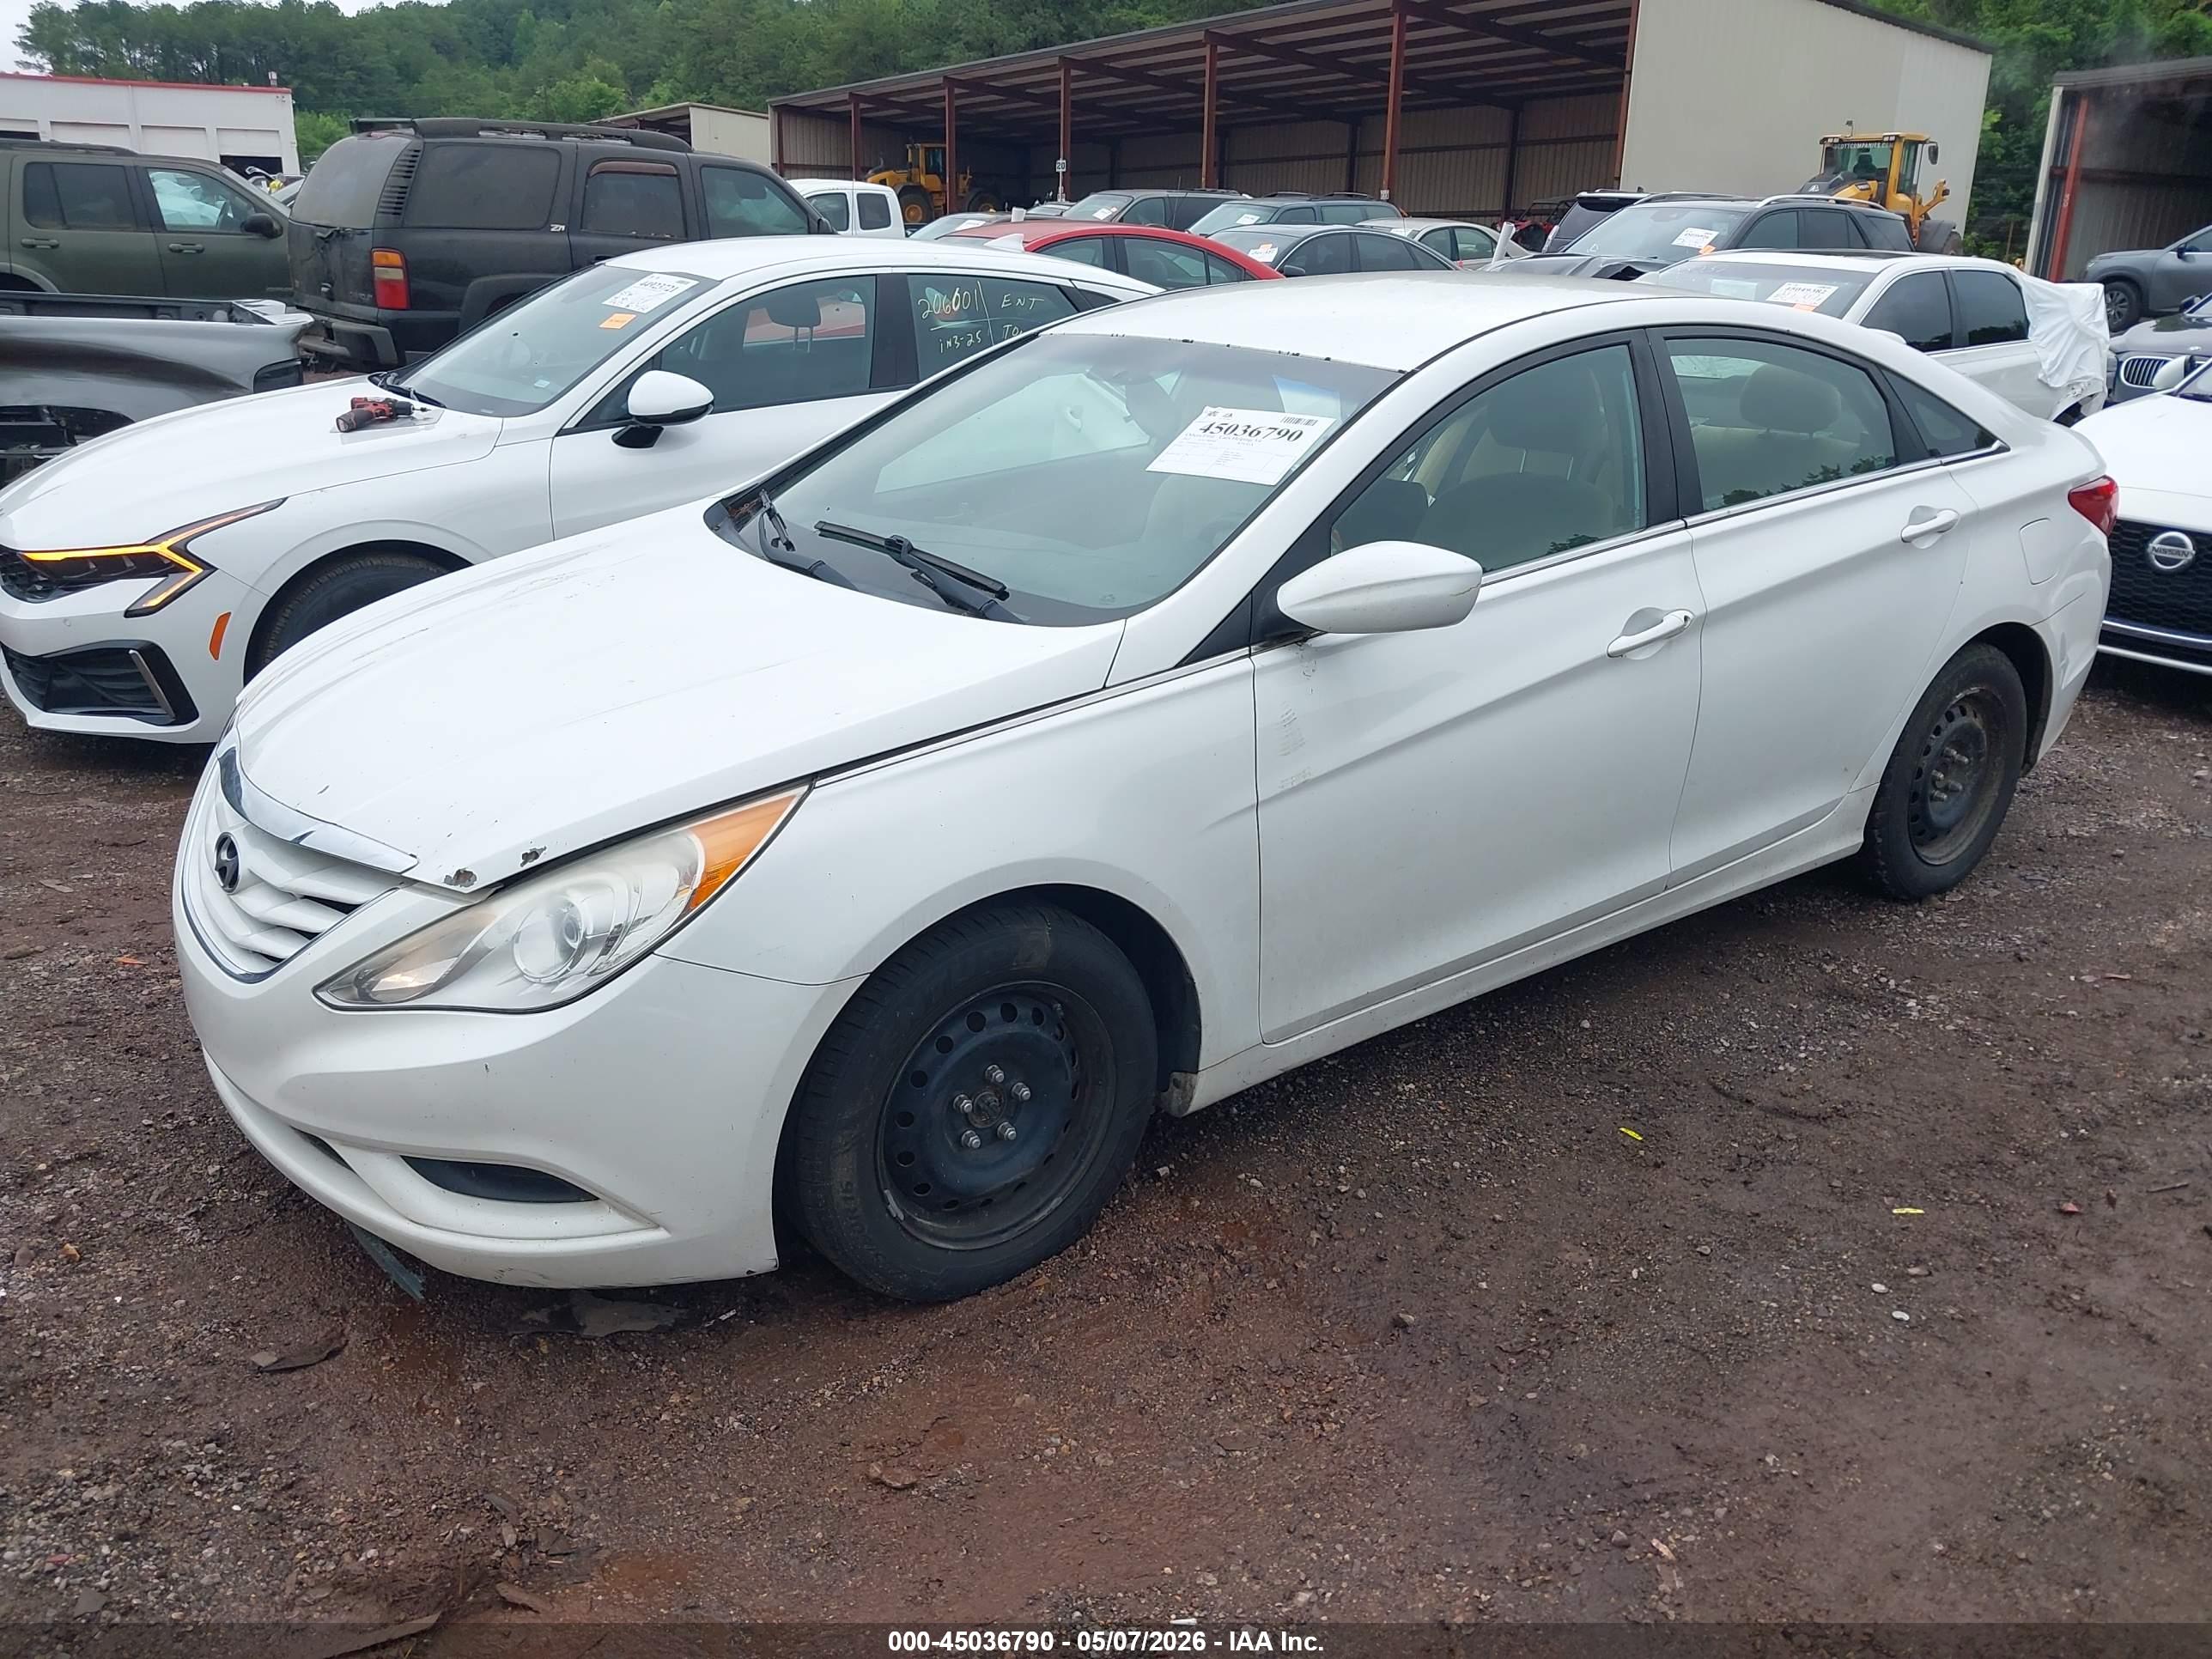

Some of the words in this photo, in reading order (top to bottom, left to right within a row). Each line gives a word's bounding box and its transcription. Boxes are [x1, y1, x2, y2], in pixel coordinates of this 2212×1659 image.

[1056, 161, 1066, 170] 20
[1001, 294, 1045, 310] ENT
[1199, 422, 1304, 442] 45036790
[2151, 546, 2190, 558] NISSAN
